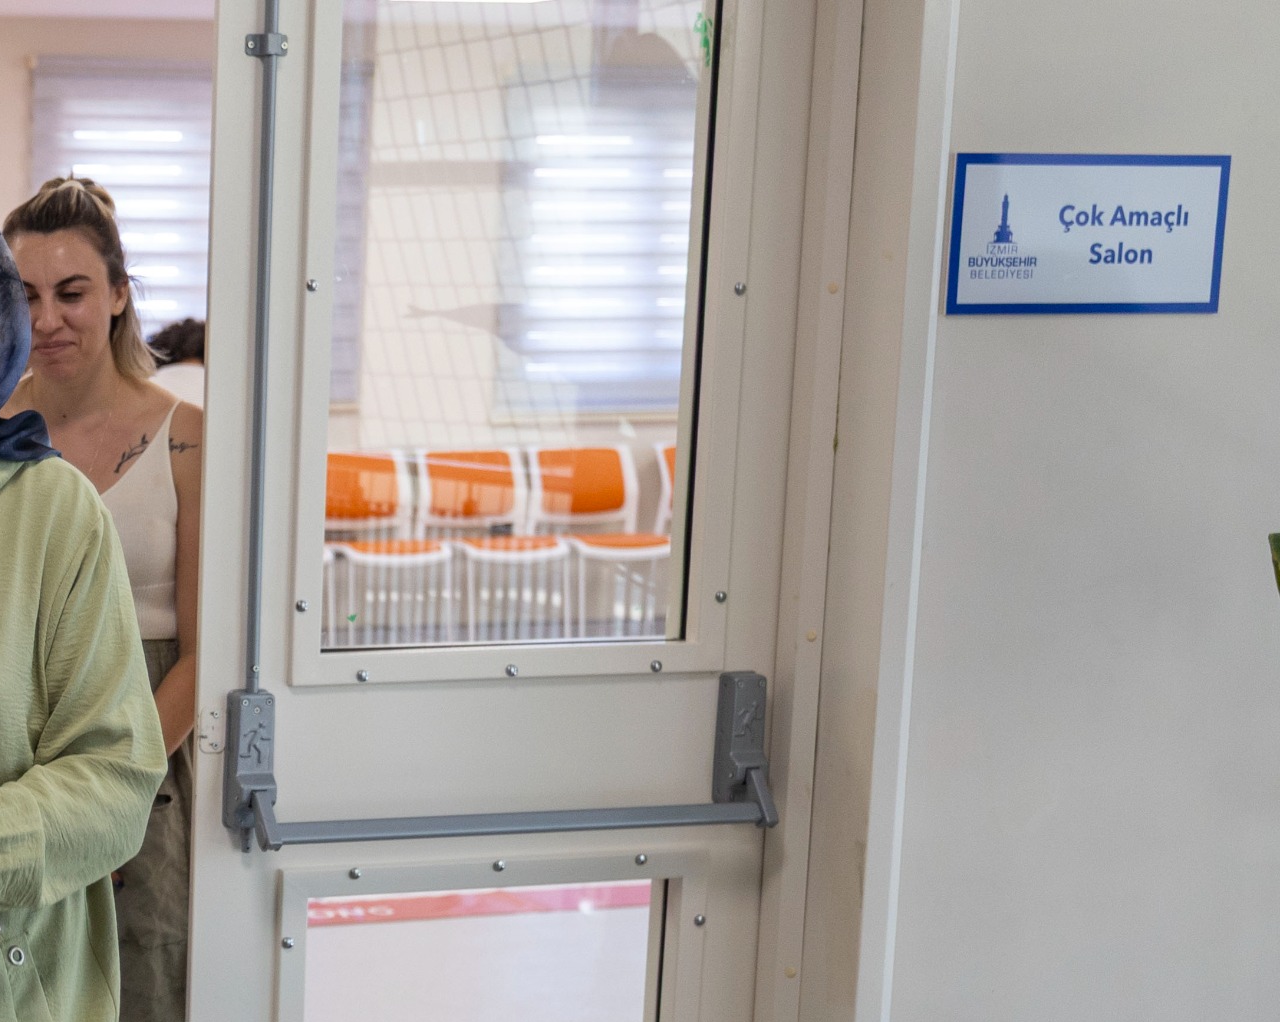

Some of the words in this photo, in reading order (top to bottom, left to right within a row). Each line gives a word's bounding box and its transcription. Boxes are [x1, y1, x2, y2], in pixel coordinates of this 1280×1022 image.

[1058, 204, 1104, 233] Çok
[1109, 204, 1189, 233] Amaçlı
[1088, 242, 1153, 265] Salon
